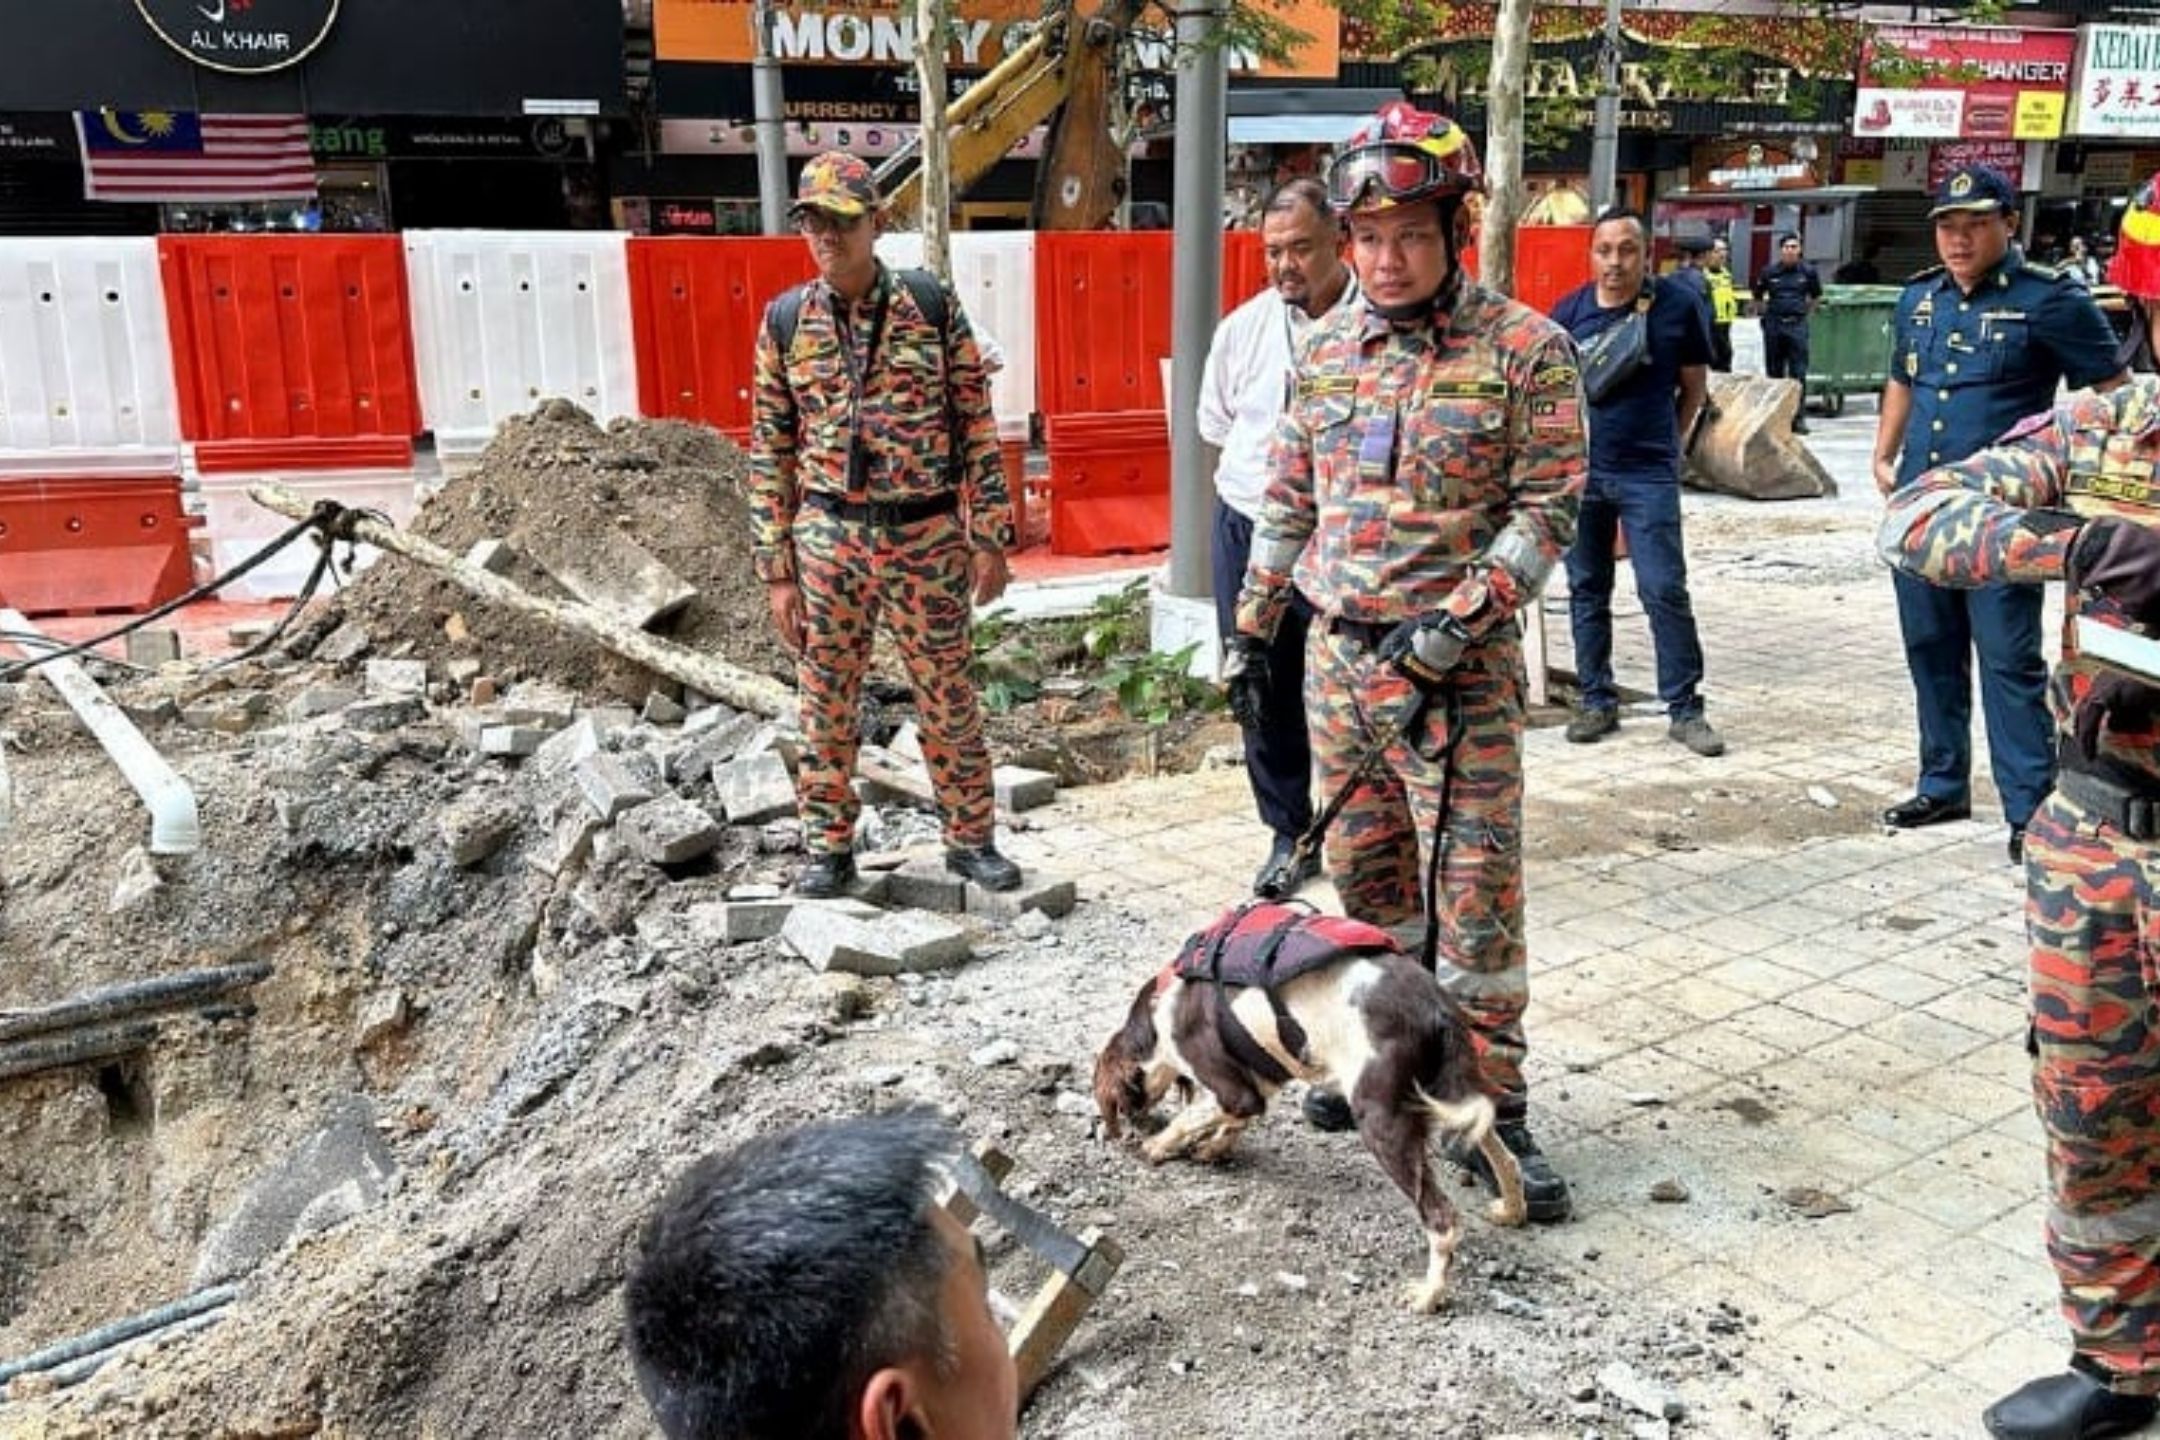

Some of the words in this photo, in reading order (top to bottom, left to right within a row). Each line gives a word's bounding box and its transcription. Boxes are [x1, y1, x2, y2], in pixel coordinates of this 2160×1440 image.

[190, 29, 218, 49] AL
[222, 30, 290, 50] KHAIR
[771, 10, 991, 64] MONY
[784, 101, 898, 119] URRENCY
